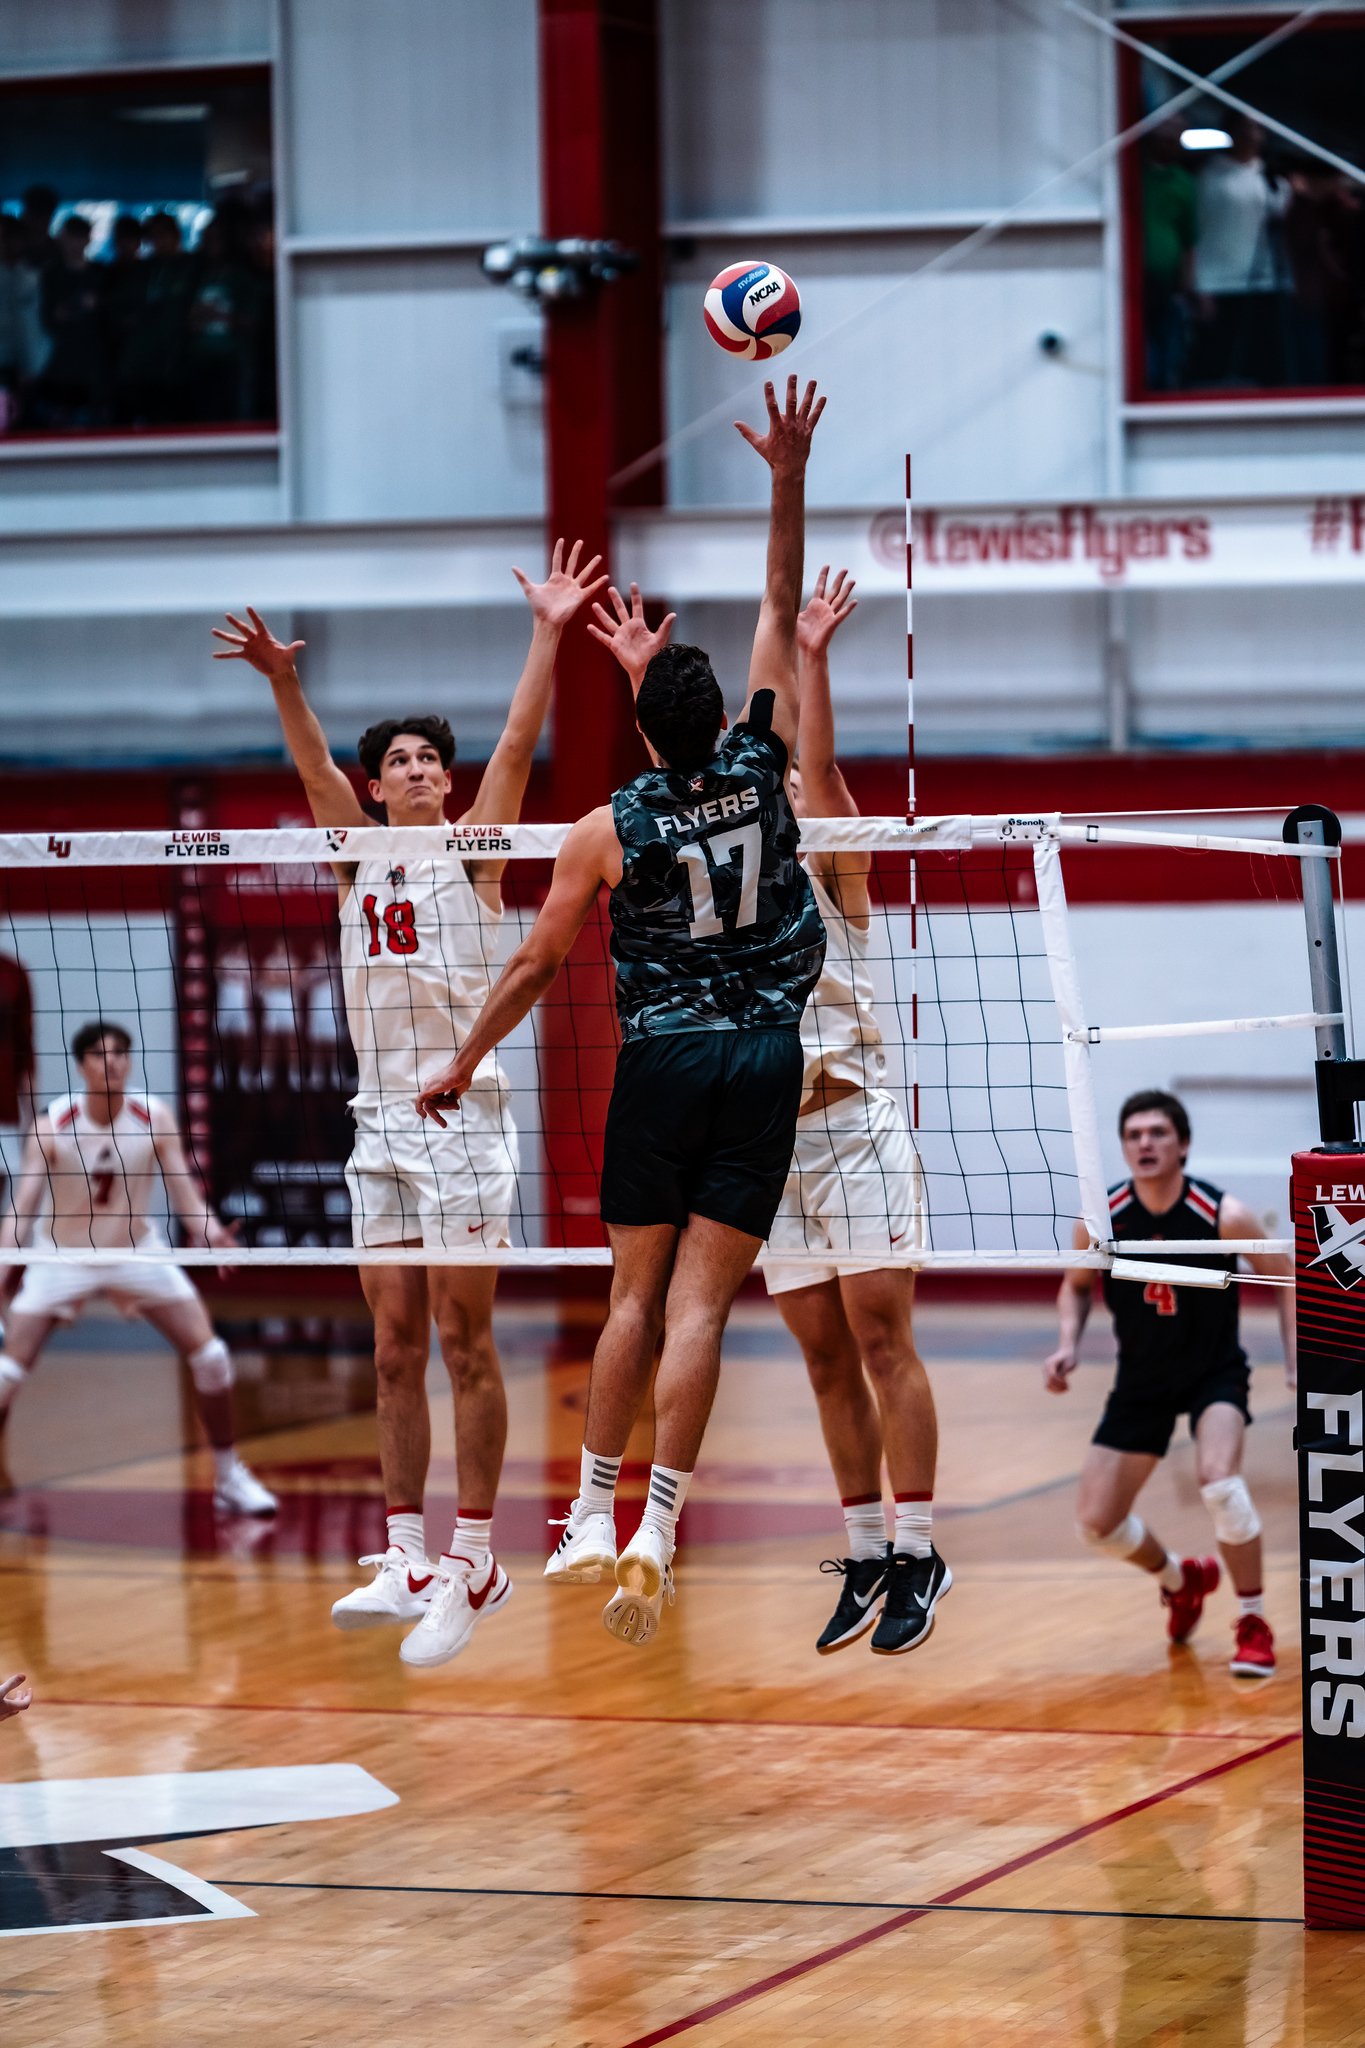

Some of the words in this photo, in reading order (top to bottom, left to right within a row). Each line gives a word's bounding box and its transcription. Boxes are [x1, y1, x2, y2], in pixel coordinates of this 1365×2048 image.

[737, 268, 767, 290] molten
[748, 281, 781, 306] NCAA
[654, 786, 760, 838] FLYERS
[1016, 818, 1045, 826] Senoh
[172, 832, 221, 843] LEWIS
[452, 826, 502, 838] LEWIS
[47, 835, 71, 859] LU
[165, 843, 230, 857] FLYERS
[445, 838, 512, 852] FLYERS
[676, 821, 763, 939] 17
[362, 893, 419, 957] 18
[1143, 1280, 1178, 1316] 4
[1307, 1389, 1365, 1740] FLYERS
